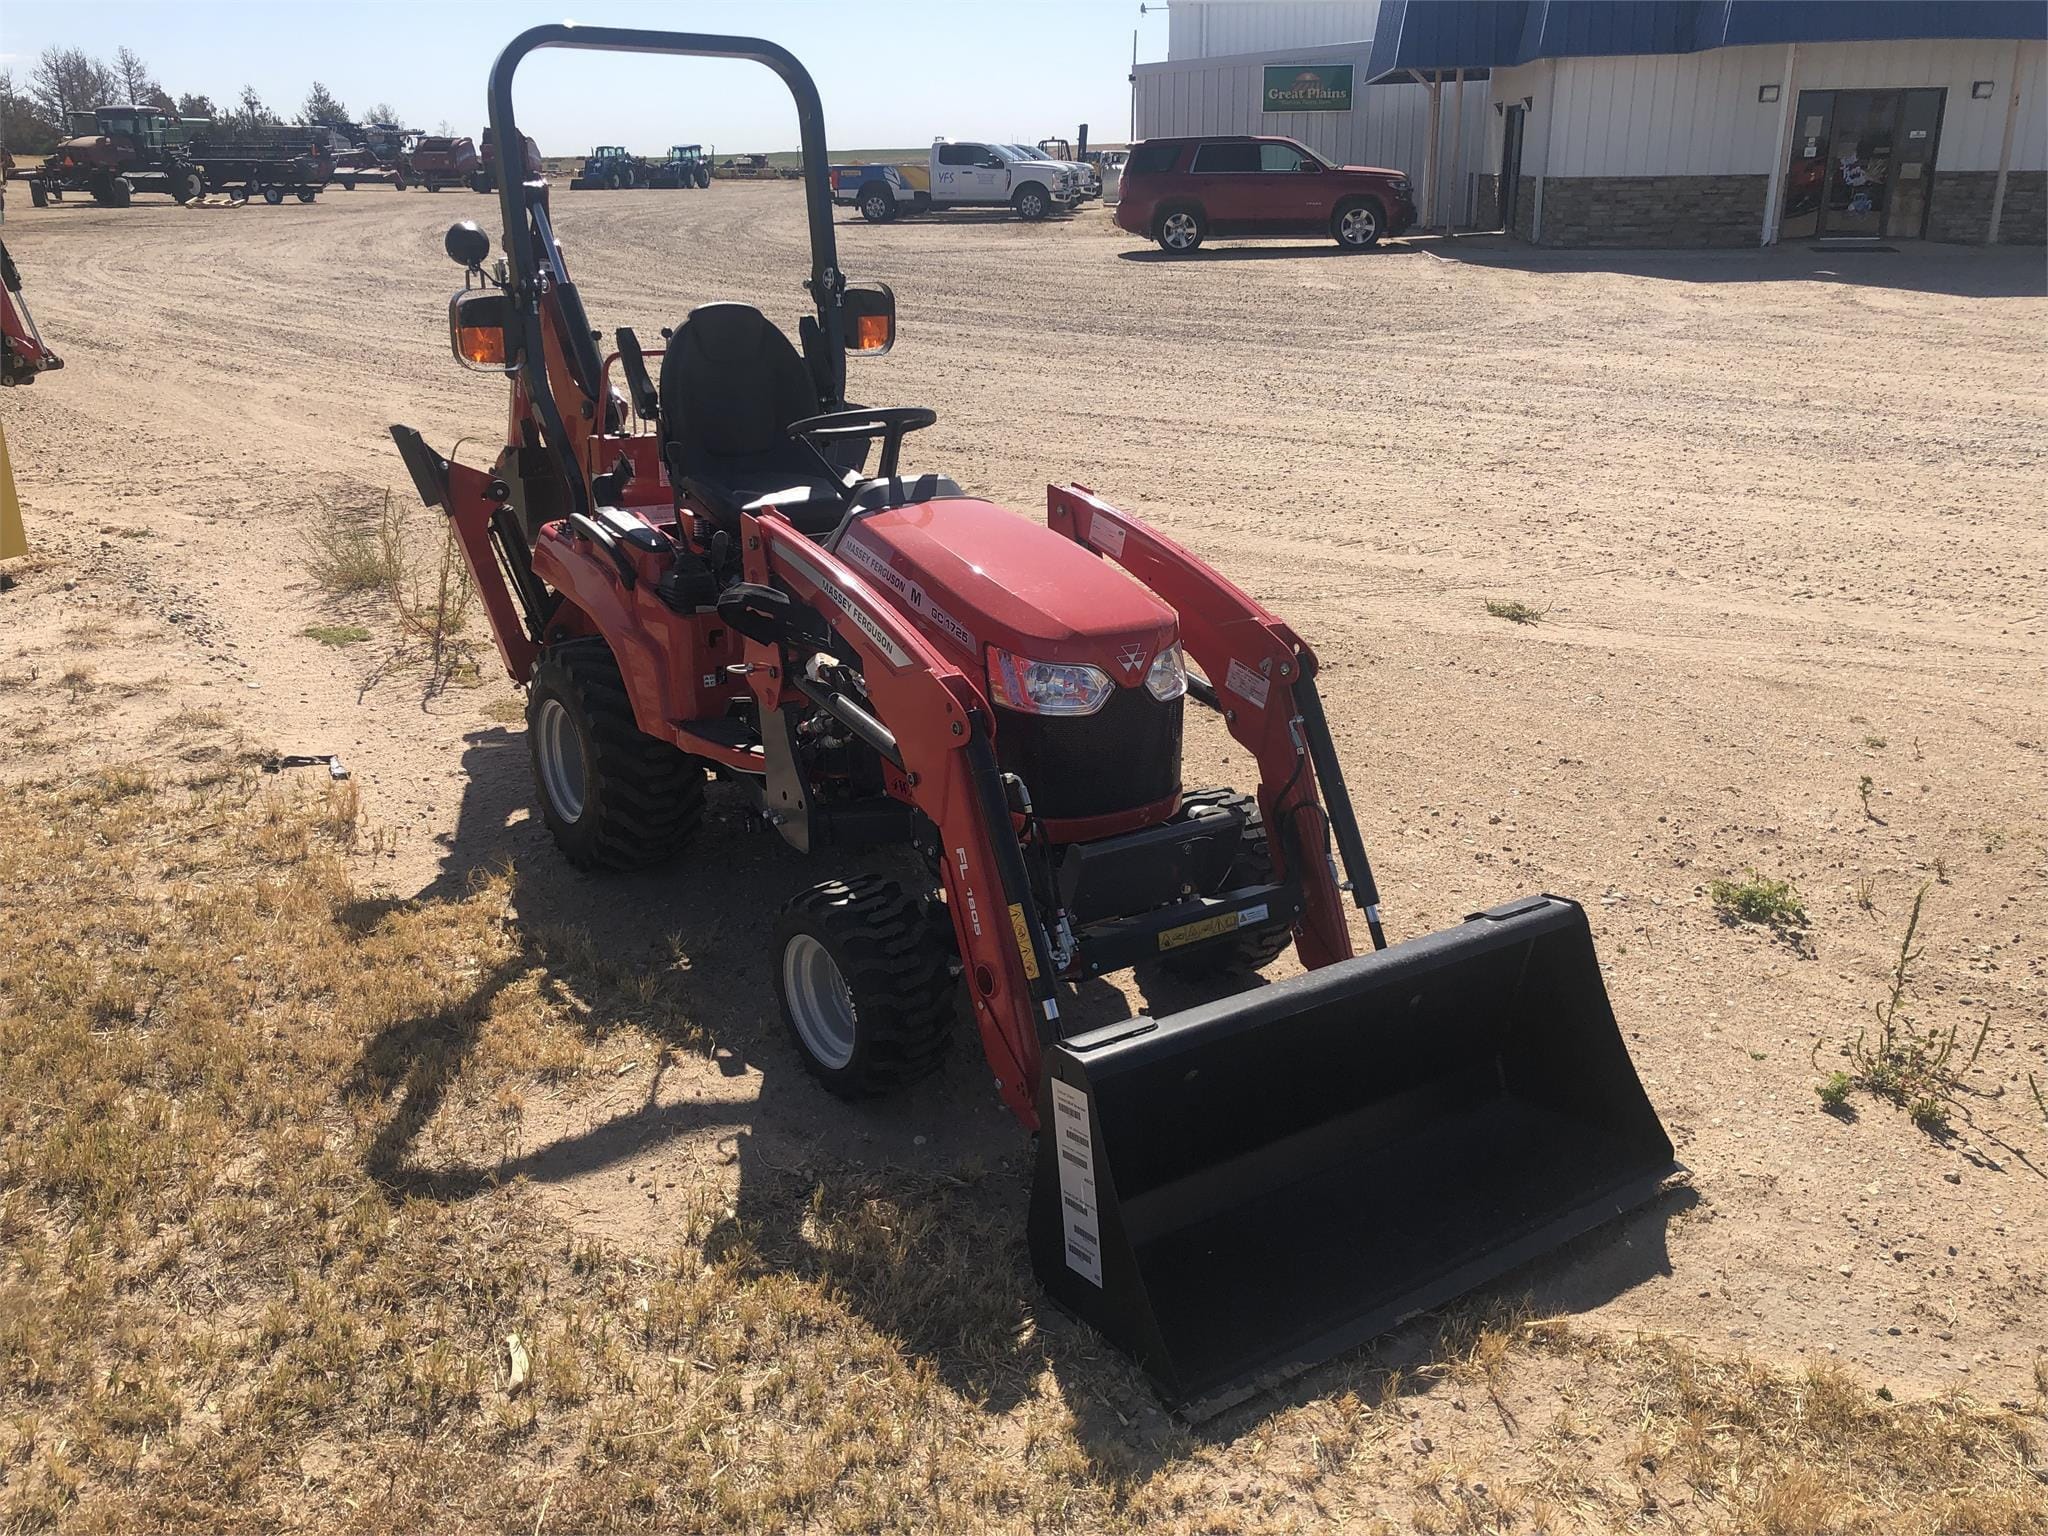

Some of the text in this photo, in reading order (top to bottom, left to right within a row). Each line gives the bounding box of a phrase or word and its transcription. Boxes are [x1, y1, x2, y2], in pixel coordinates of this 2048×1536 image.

[1268, 88, 1347, 99] Great Plains
[847, 541, 871, 562] MASSEY
[870, 561, 906, 593] FERGUSON
[910, 587, 922, 607] M
[822, 580, 893, 654] MASSEY FERGUSON
[956, 848, 969, 881] FL
